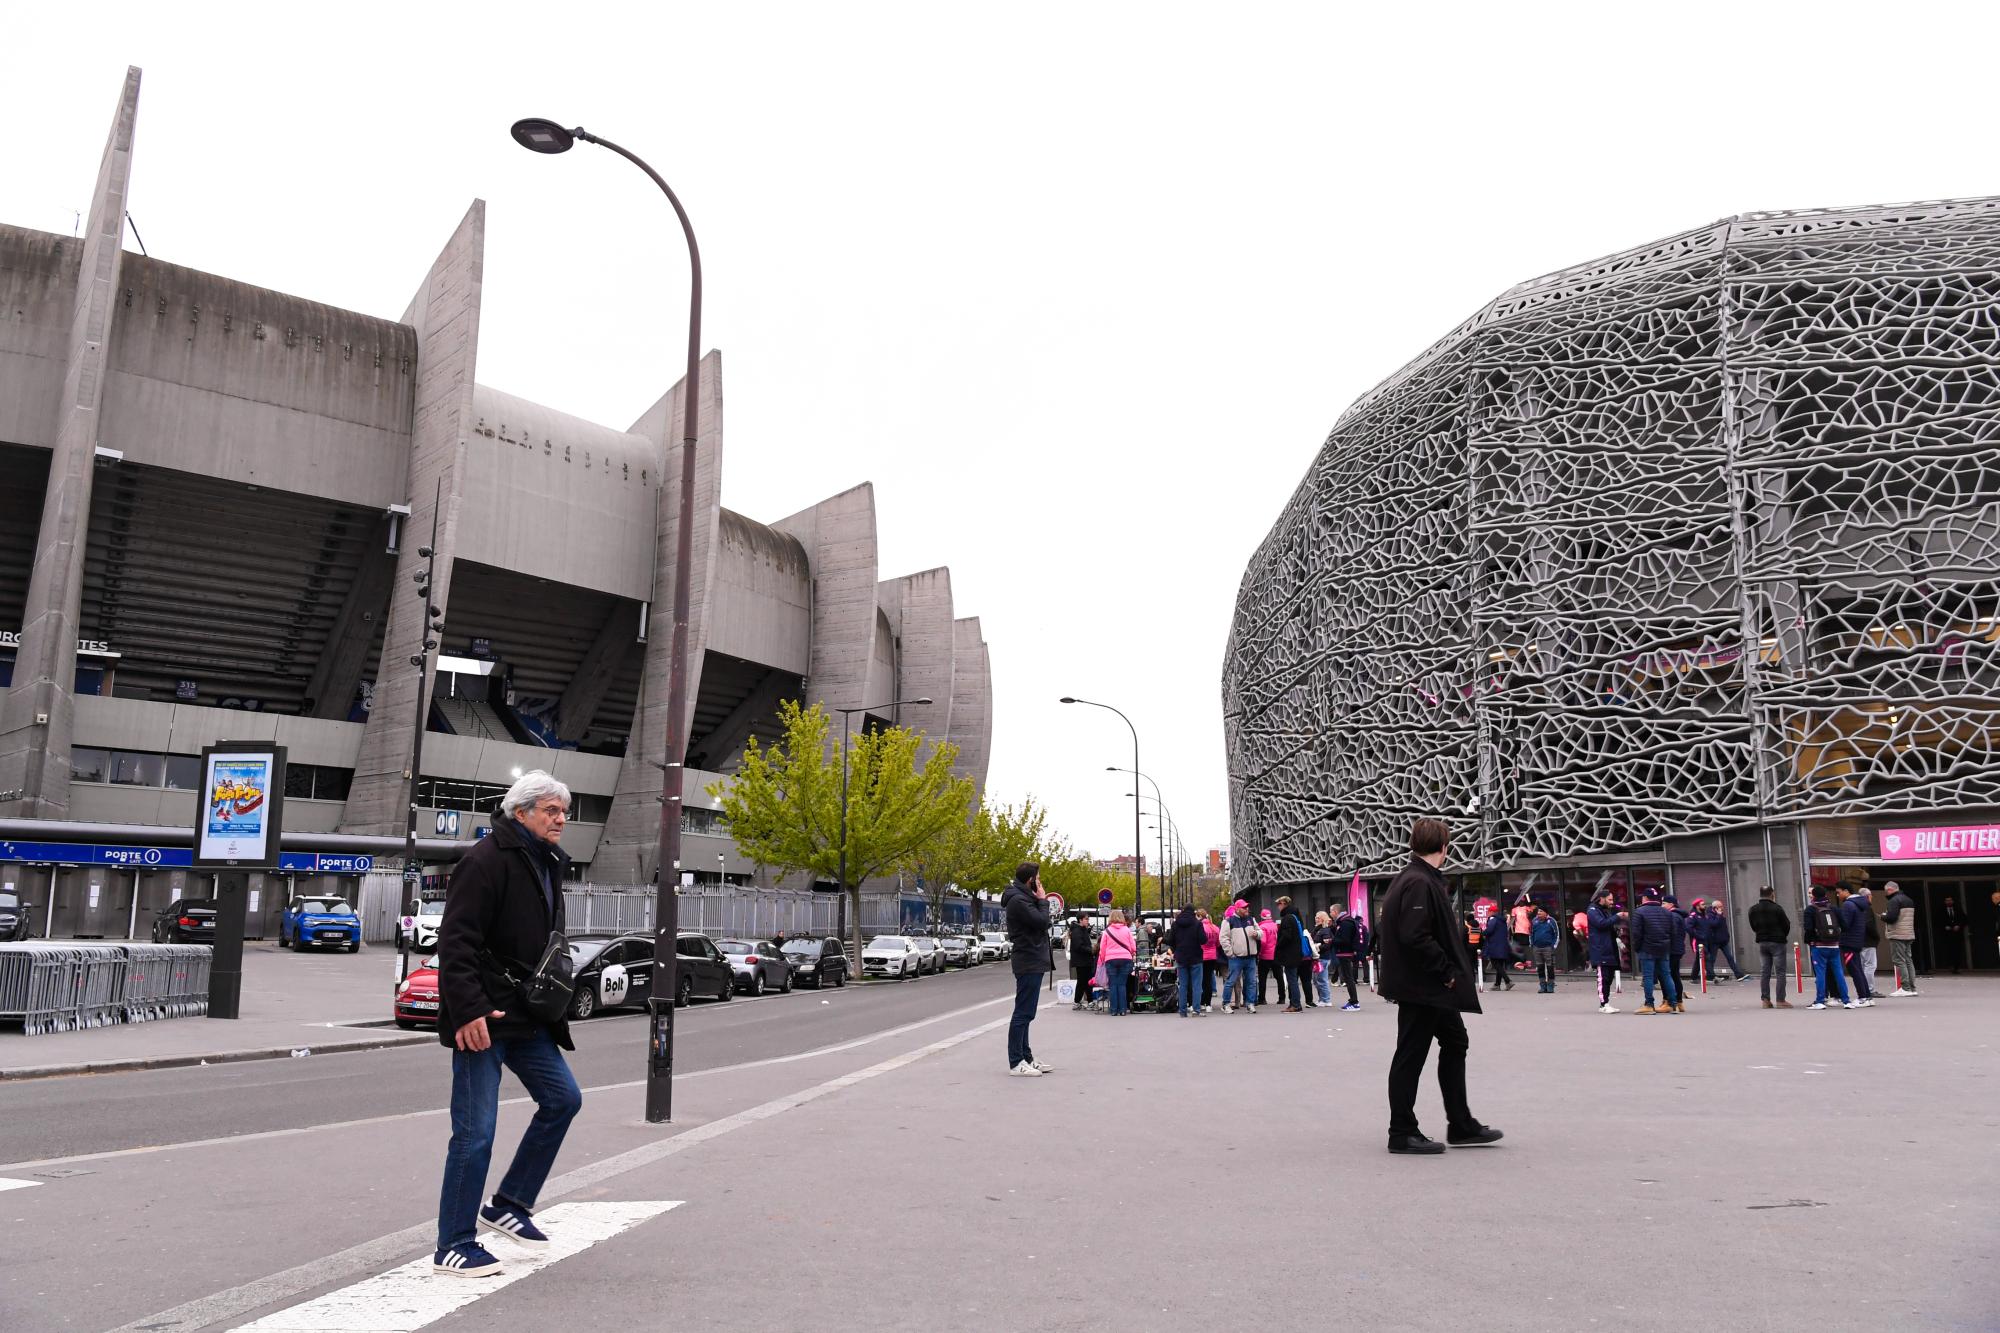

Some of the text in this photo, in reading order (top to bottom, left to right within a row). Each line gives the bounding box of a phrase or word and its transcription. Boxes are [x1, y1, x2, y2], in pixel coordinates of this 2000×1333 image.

[1914, 828, 1999, 853] BILLETTER
[105, 851, 141, 860] PORTE
[320, 858, 352, 867] PORTE
[605, 977, 624, 993] Bolt
